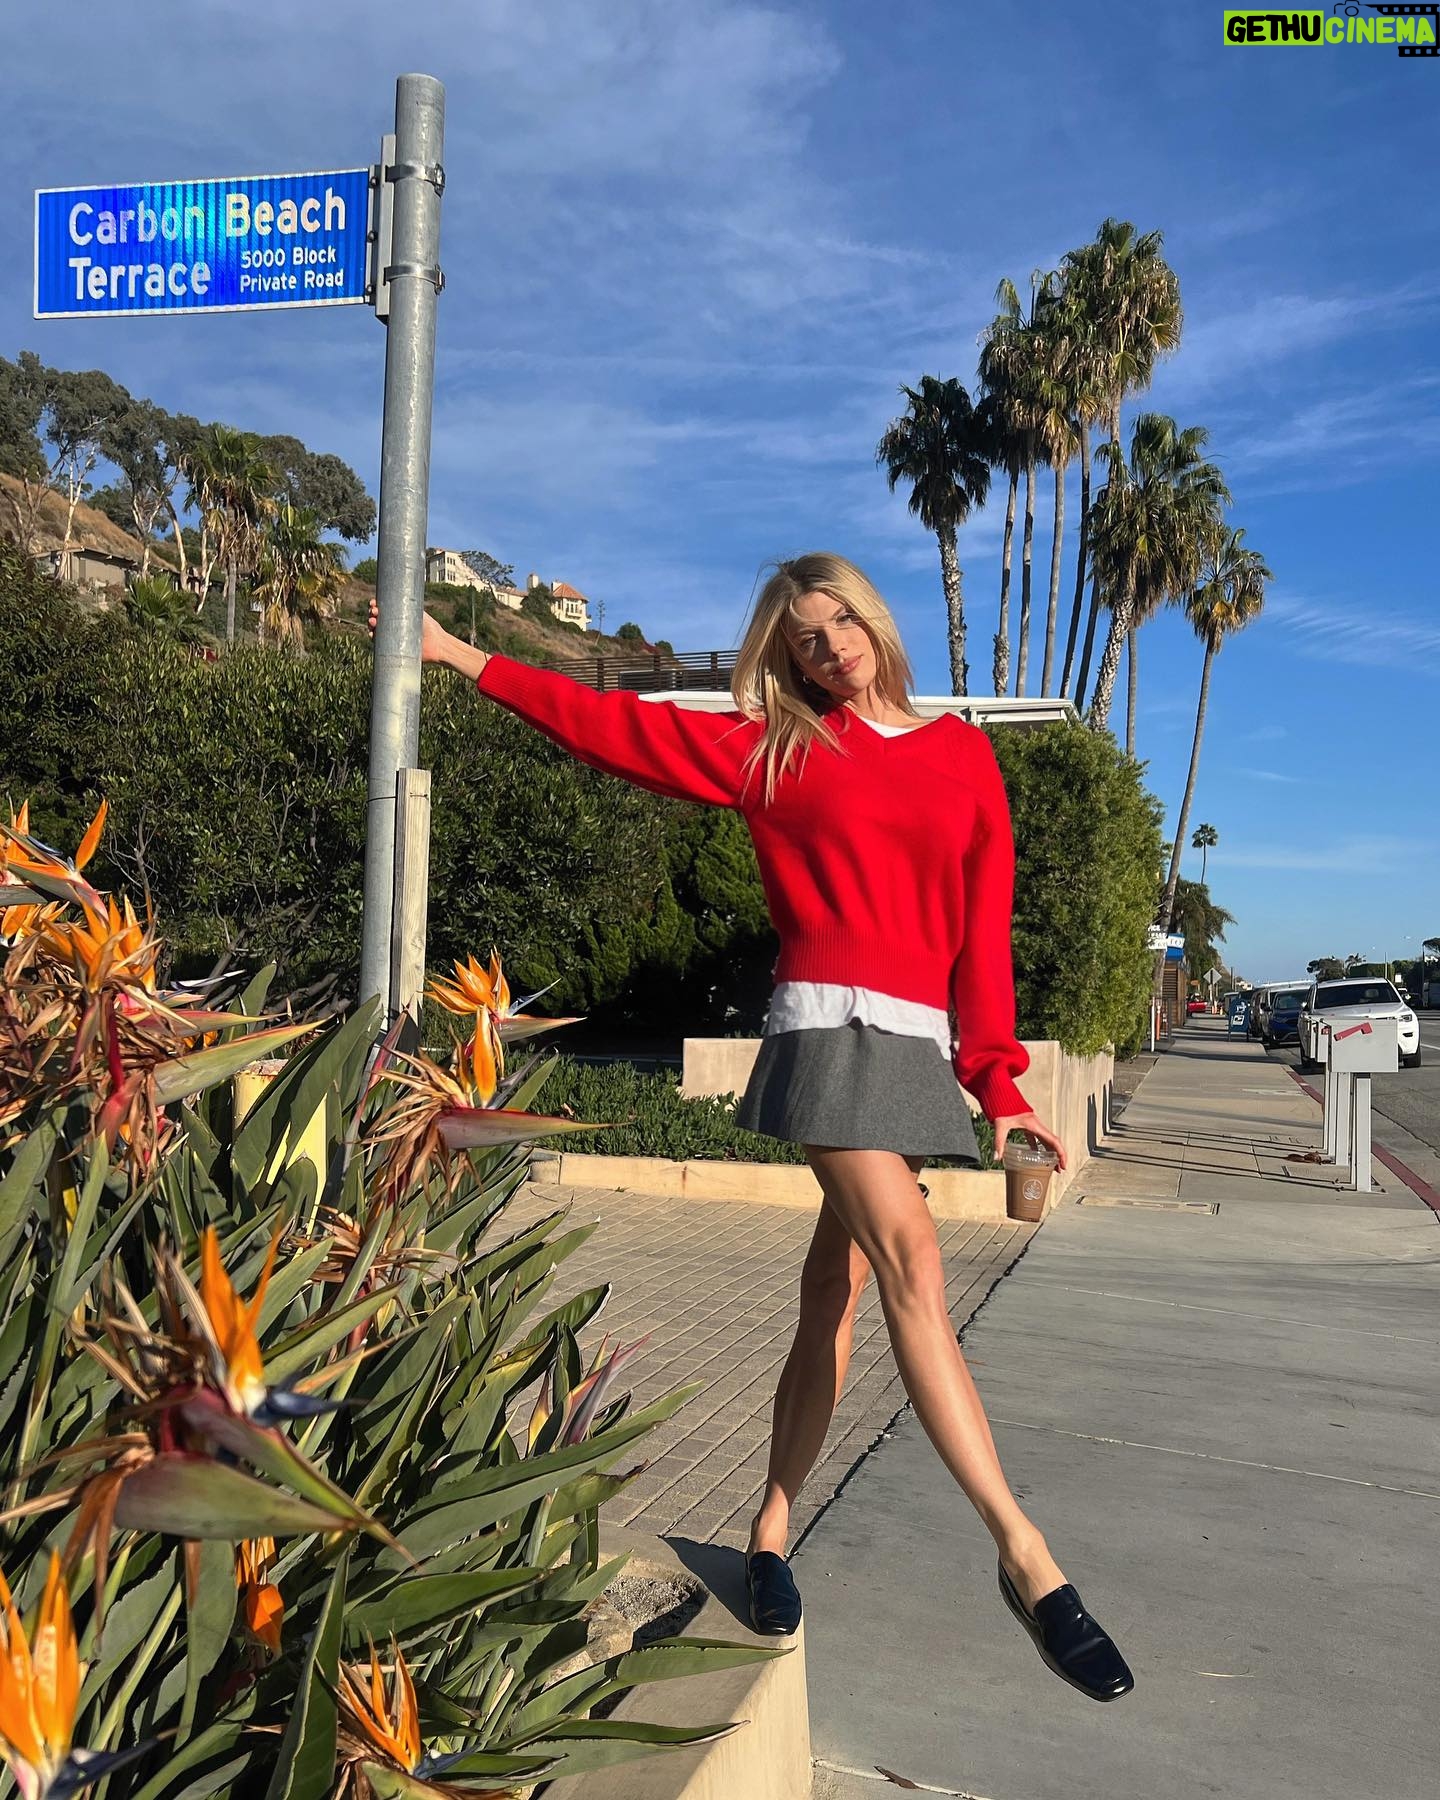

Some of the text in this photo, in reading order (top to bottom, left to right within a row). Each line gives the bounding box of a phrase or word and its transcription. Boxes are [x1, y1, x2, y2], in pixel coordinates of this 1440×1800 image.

[68, 187, 346, 247] Carbon Beach
[240, 246, 336, 269] 5000 Block
[68, 256, 212, 301] Terrace
[239, 269, 345, 293] Private Road
